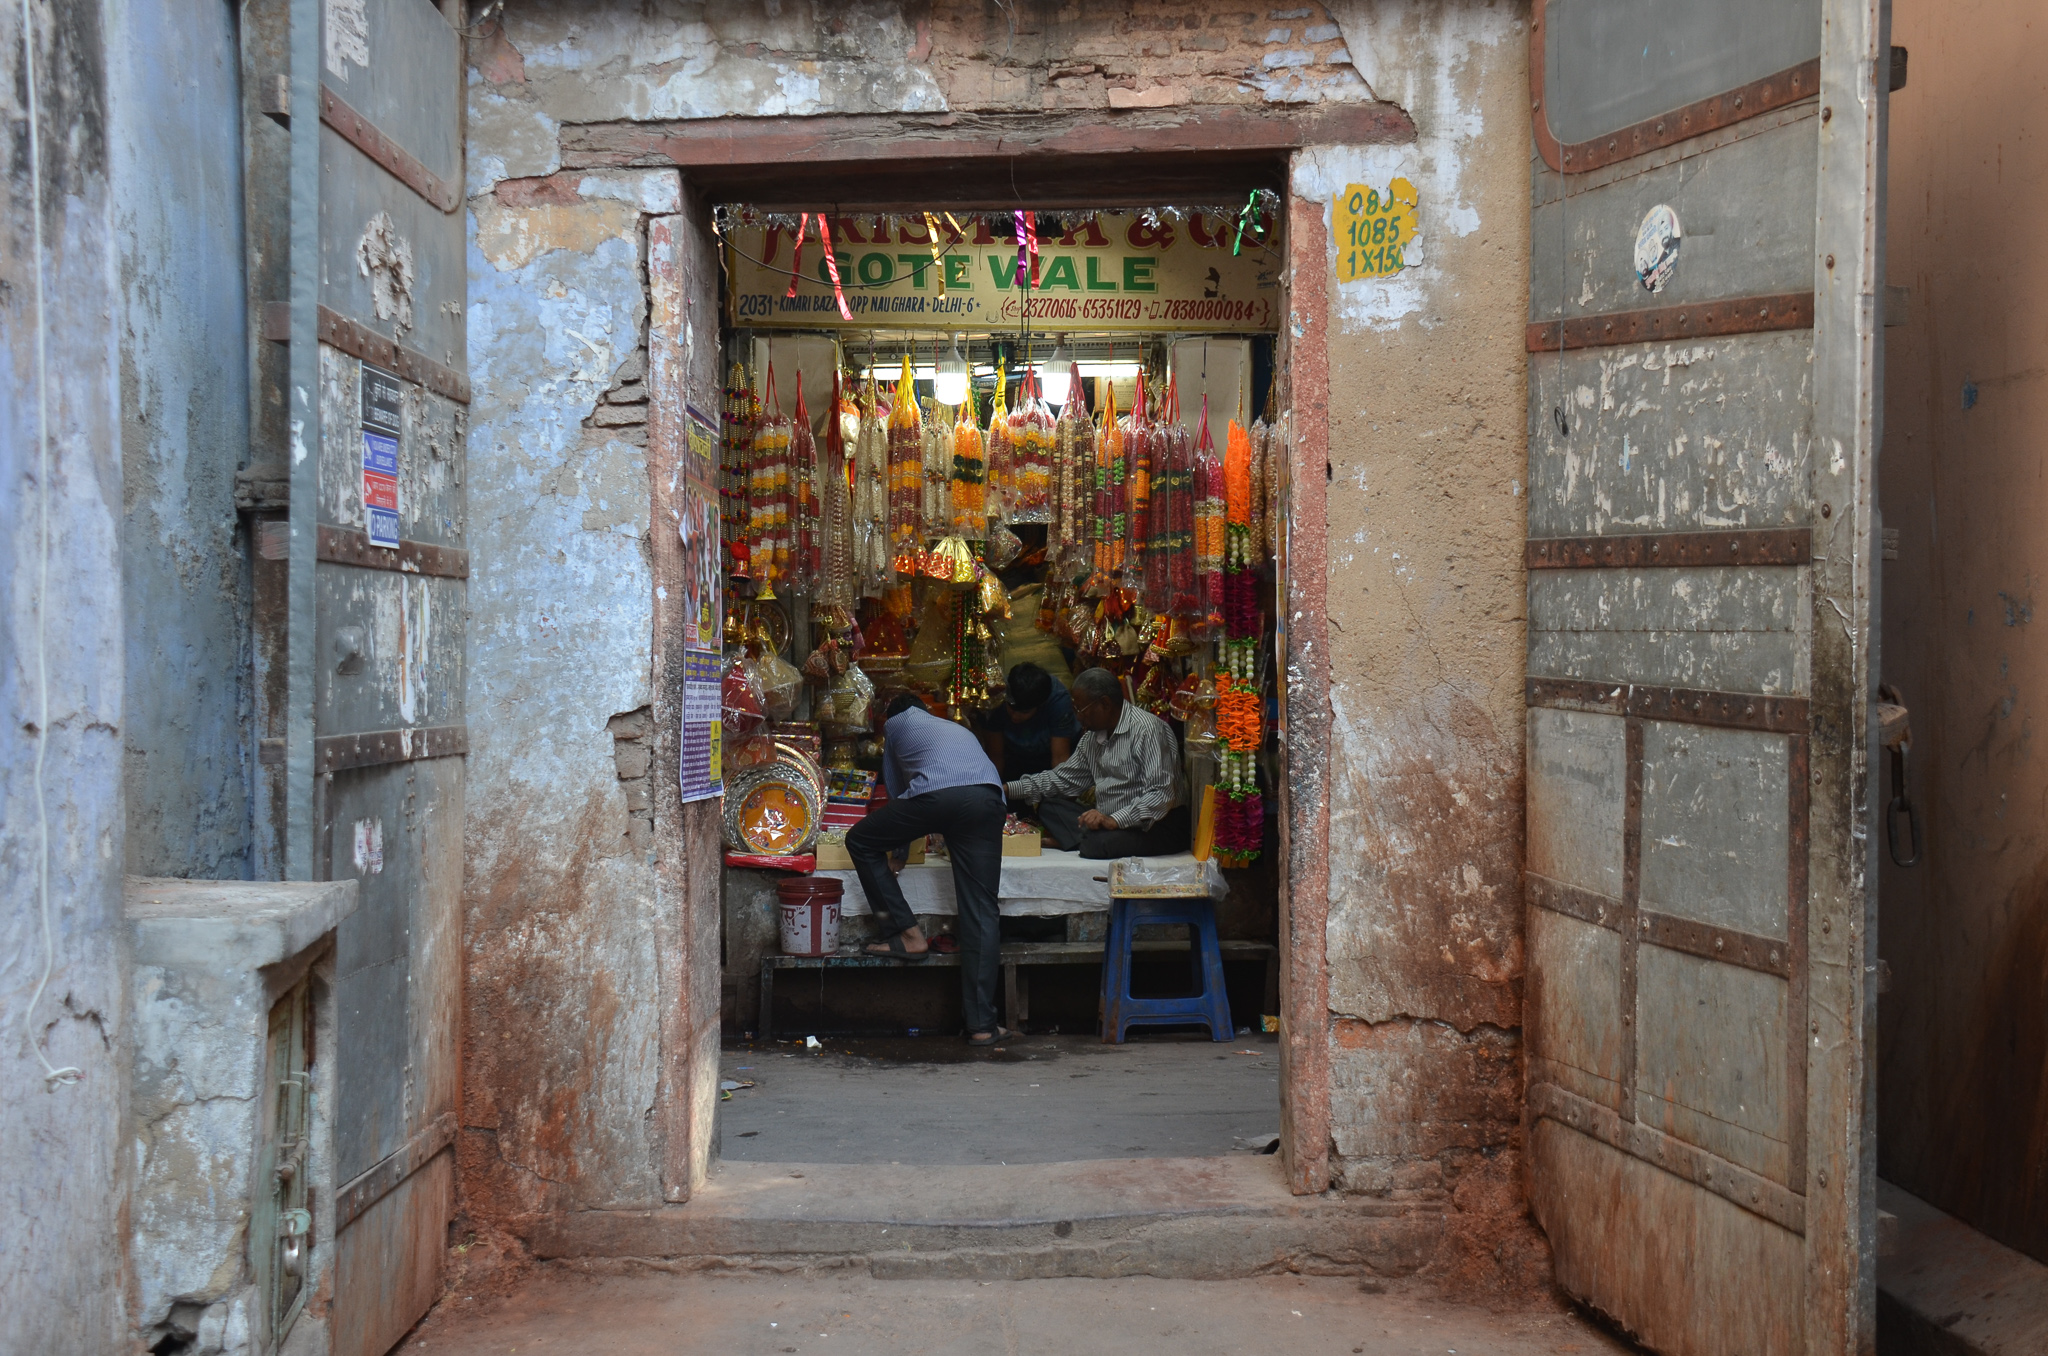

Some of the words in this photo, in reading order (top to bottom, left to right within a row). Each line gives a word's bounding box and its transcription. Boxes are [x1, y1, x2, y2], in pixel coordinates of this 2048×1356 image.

[1347, 215, 1401, 247] 1085
[818, 252, 972, 290] GOTE
[987, 255, 1157, 291] WALE
[739, 294, 772, 316] 2031
[779, 296, 811, 312] KINARI
[813, 296, 842, 312] BAZA
[850, 296, 869, 312] OPP
[892, 297, 924, 312] GHARA
[376, 514, 398, 540] PARKING
